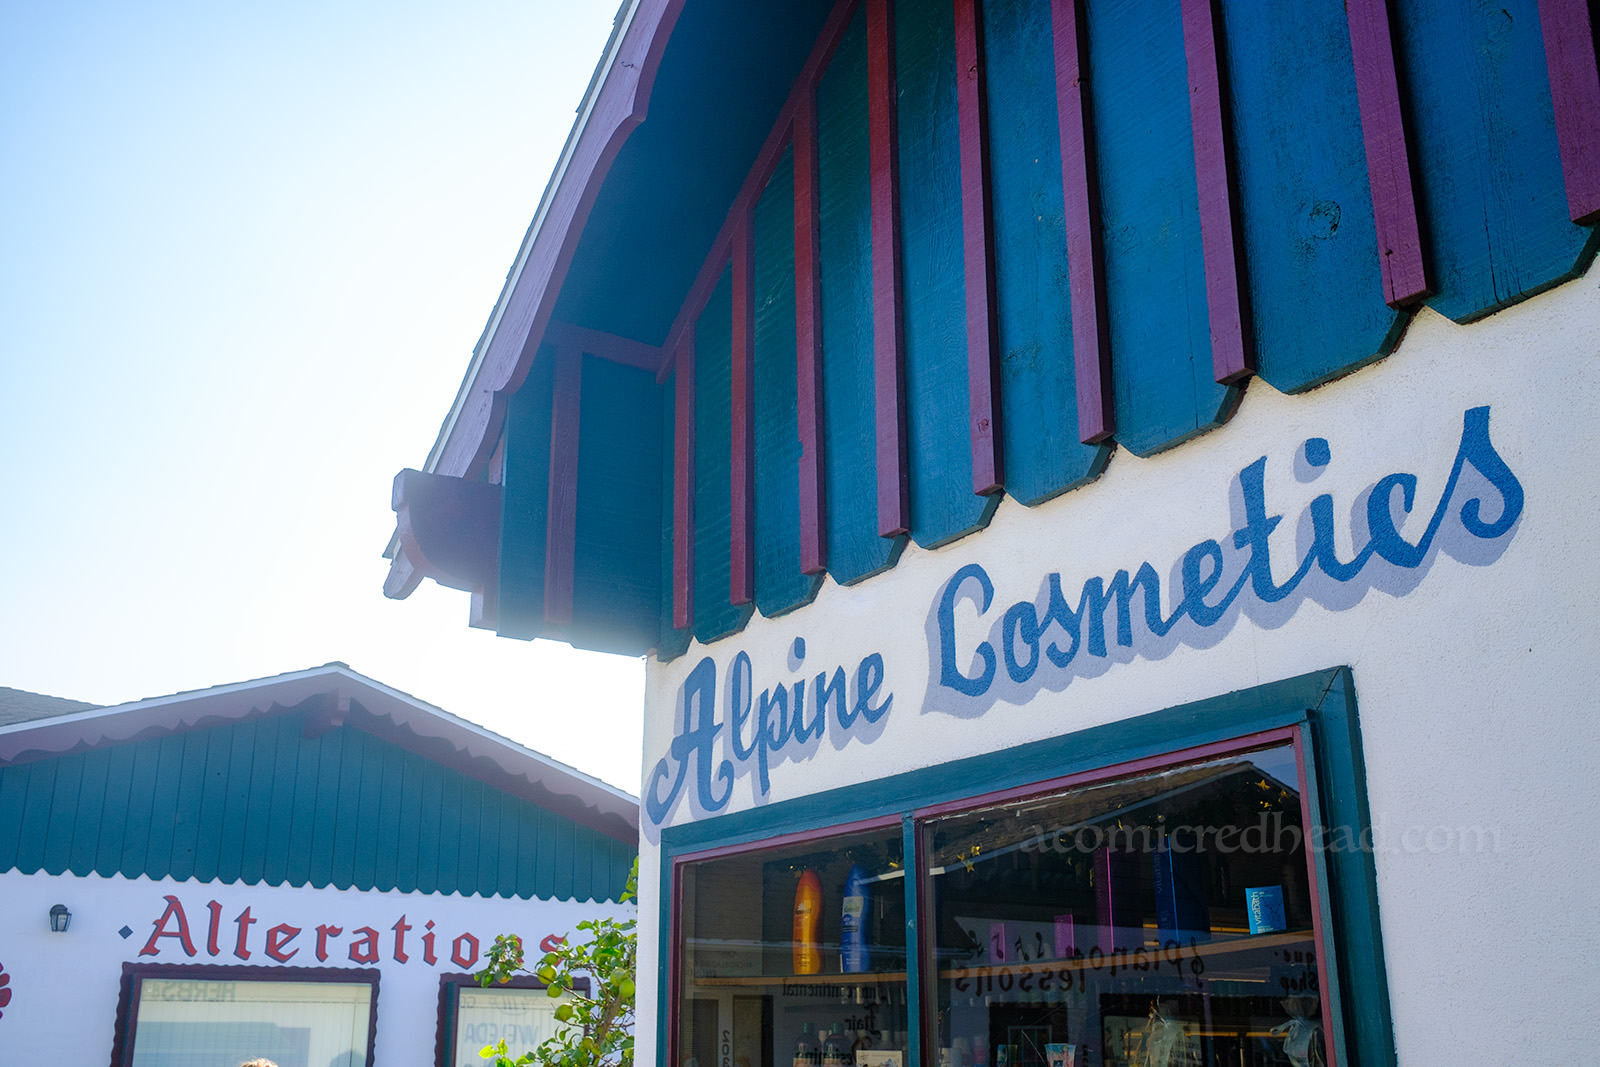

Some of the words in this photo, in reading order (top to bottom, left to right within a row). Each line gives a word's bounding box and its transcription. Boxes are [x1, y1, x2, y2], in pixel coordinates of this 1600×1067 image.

[645, 636, 894, 826] Alpine
[939, 405, 1525, 697] Cosmetics
[1250, 891, 1262, 924] vitabath
